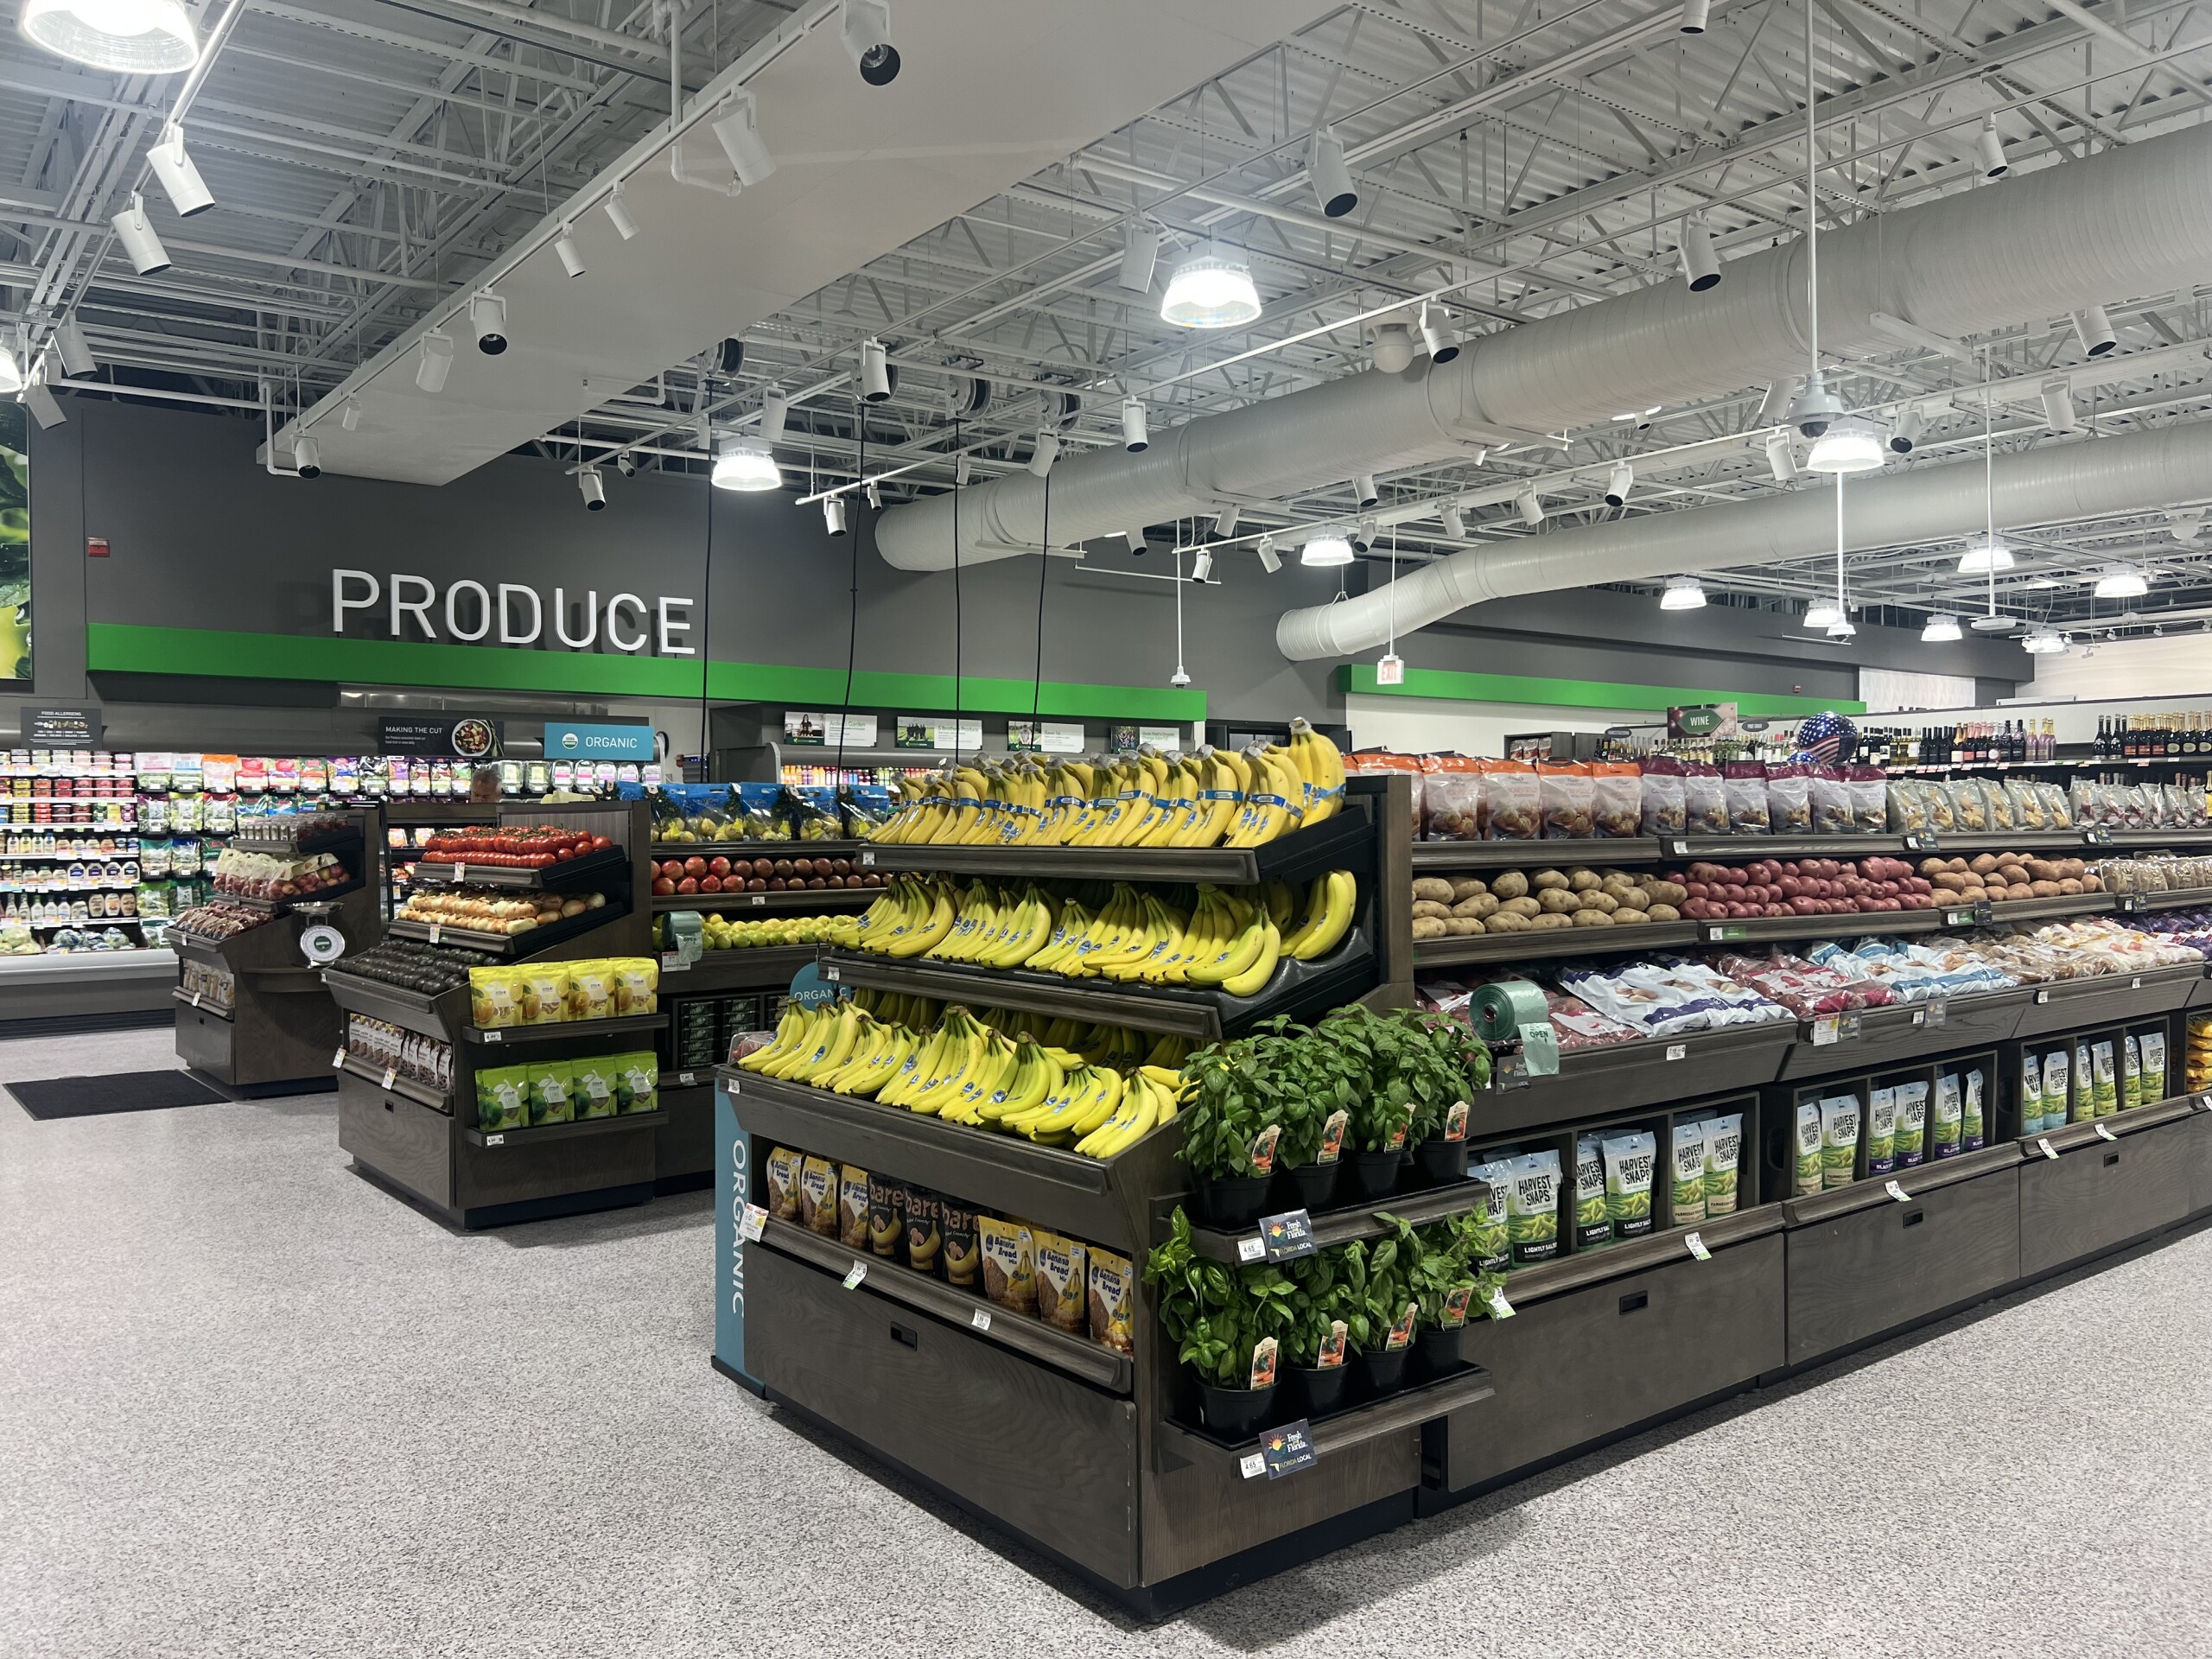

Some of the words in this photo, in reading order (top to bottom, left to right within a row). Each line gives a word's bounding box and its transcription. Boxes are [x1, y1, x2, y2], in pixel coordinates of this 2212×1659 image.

[333, 569, 695, 655] PRODUCE
[1382, 664, 1397, 681] EXIT
[1690, 715, 1709, 727] WINE
[586, 736, 638, 748] ORGANIC
[794, 987, 847, 1001] ORGANC
[1529, 1030, 1549, 1039] OPEN
[1834, 1114, 1857, 1130] HARVEST
[1838, 1126, 1855, 1139] SNAPS
[1714, 1135, 1738, 1154] HARVEST
[1677, 1142, 1704, 1163] HARVEST
[1719, 1148, 1737, 1163] SNAPS
[774, 1161, 788, 1172] Banana
[1619, 1155, 1650, 1175] HARVEST
[776, 1169, 789, 1180] Bread
[809, 1172, 825, 1184] Banana
[1580, 1173, 1604, 1190] SNAPS
[1625, 1169, 1649, 1185] SNAPS
[810, 1181, 825, 1191] Bread
[1518, 1174, 1552, 1195] HARVEST
[852, 1192, 868, 1203] Bread
[868, 1177, 904, 1207] bare
[1526, 1190, 1551, 1206] SNAPS
[905, 1188, 938, 1218] bare
[942, 1201, 979, 1231] bare
[733, 1139, 747, 1318] ORGANIC
[1286, 1219, 1302, 1230] Fresh
[1586, 1227, 1604, 1236] LIGHTLY
[1624, 1221, 1643, 1230] LIGHTLY
[1286, 1230, 1306, 1240] Florida
[995, 1236, 1015, 1249] Banana
[997, 1247, 1017, 1259] Bread
[1280, 1246, 1297, 1255] FLORIDA
[1046, 1251, 1070, 1266] Banana
[1050, 1262, 1070, 1275] Bread
[1099, 1268, 1121, 1286] Banana
[1102, 1281, 1122, 1296] Bread
[1287, 1431, 1302, 1442] Fresh
[1287, 1440, 1307, 1452] Florida
[1280, 1459, 1297, 1469] FLORIDA
[1297, 1454, 1312, 1463] LOCAL
